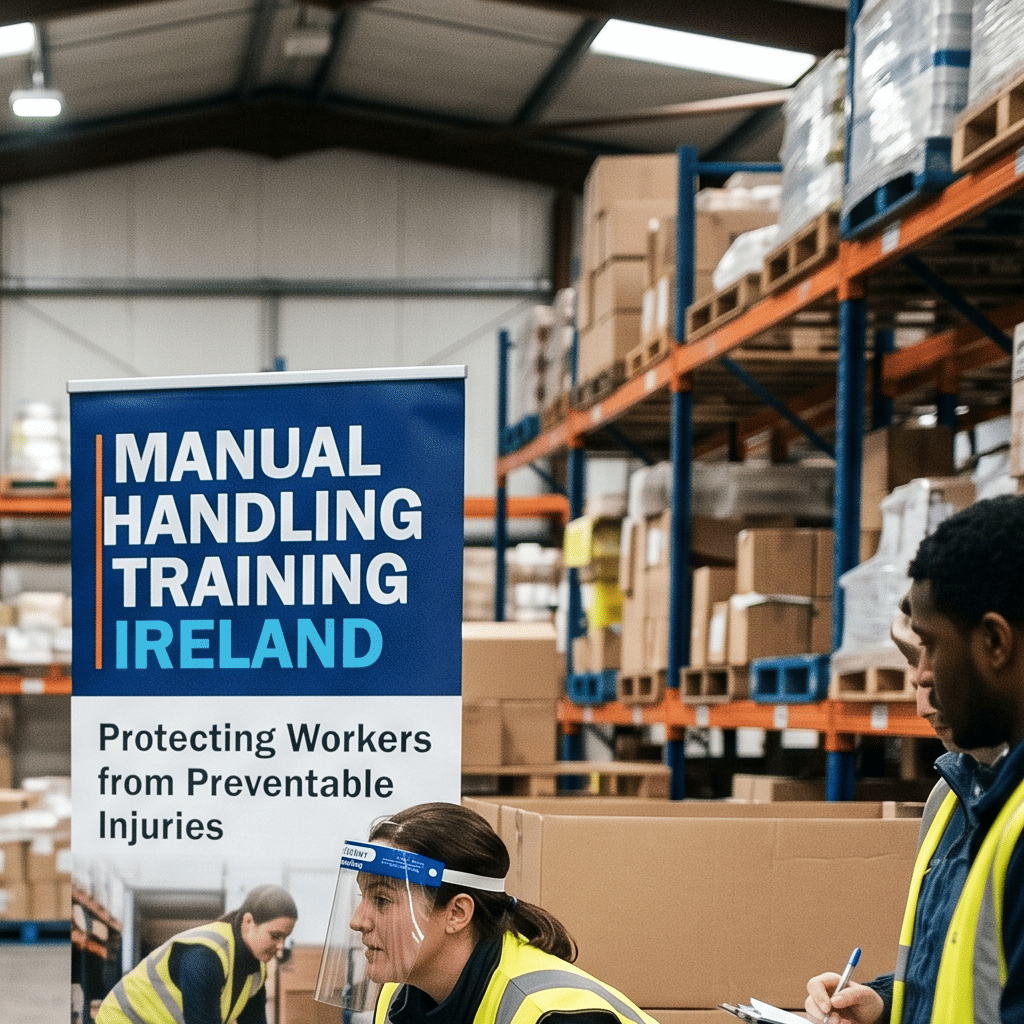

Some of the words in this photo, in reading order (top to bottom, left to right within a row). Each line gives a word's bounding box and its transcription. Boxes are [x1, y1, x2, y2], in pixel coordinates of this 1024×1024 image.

[115, 425, 381, 484] MANUAL
[103, 487, 422, 546] HANDLING
[112, 552, 408, 608] TRAINING
[115, 618, 383, 670] IRELAND
[98, 722, 277, 760] Protecting
[286, 723, 432, 754] Workers
[97, 766, 174, 796] from
[187, 767, 394, 799] Preventable
[98, 810, 224, 847] Injuries
